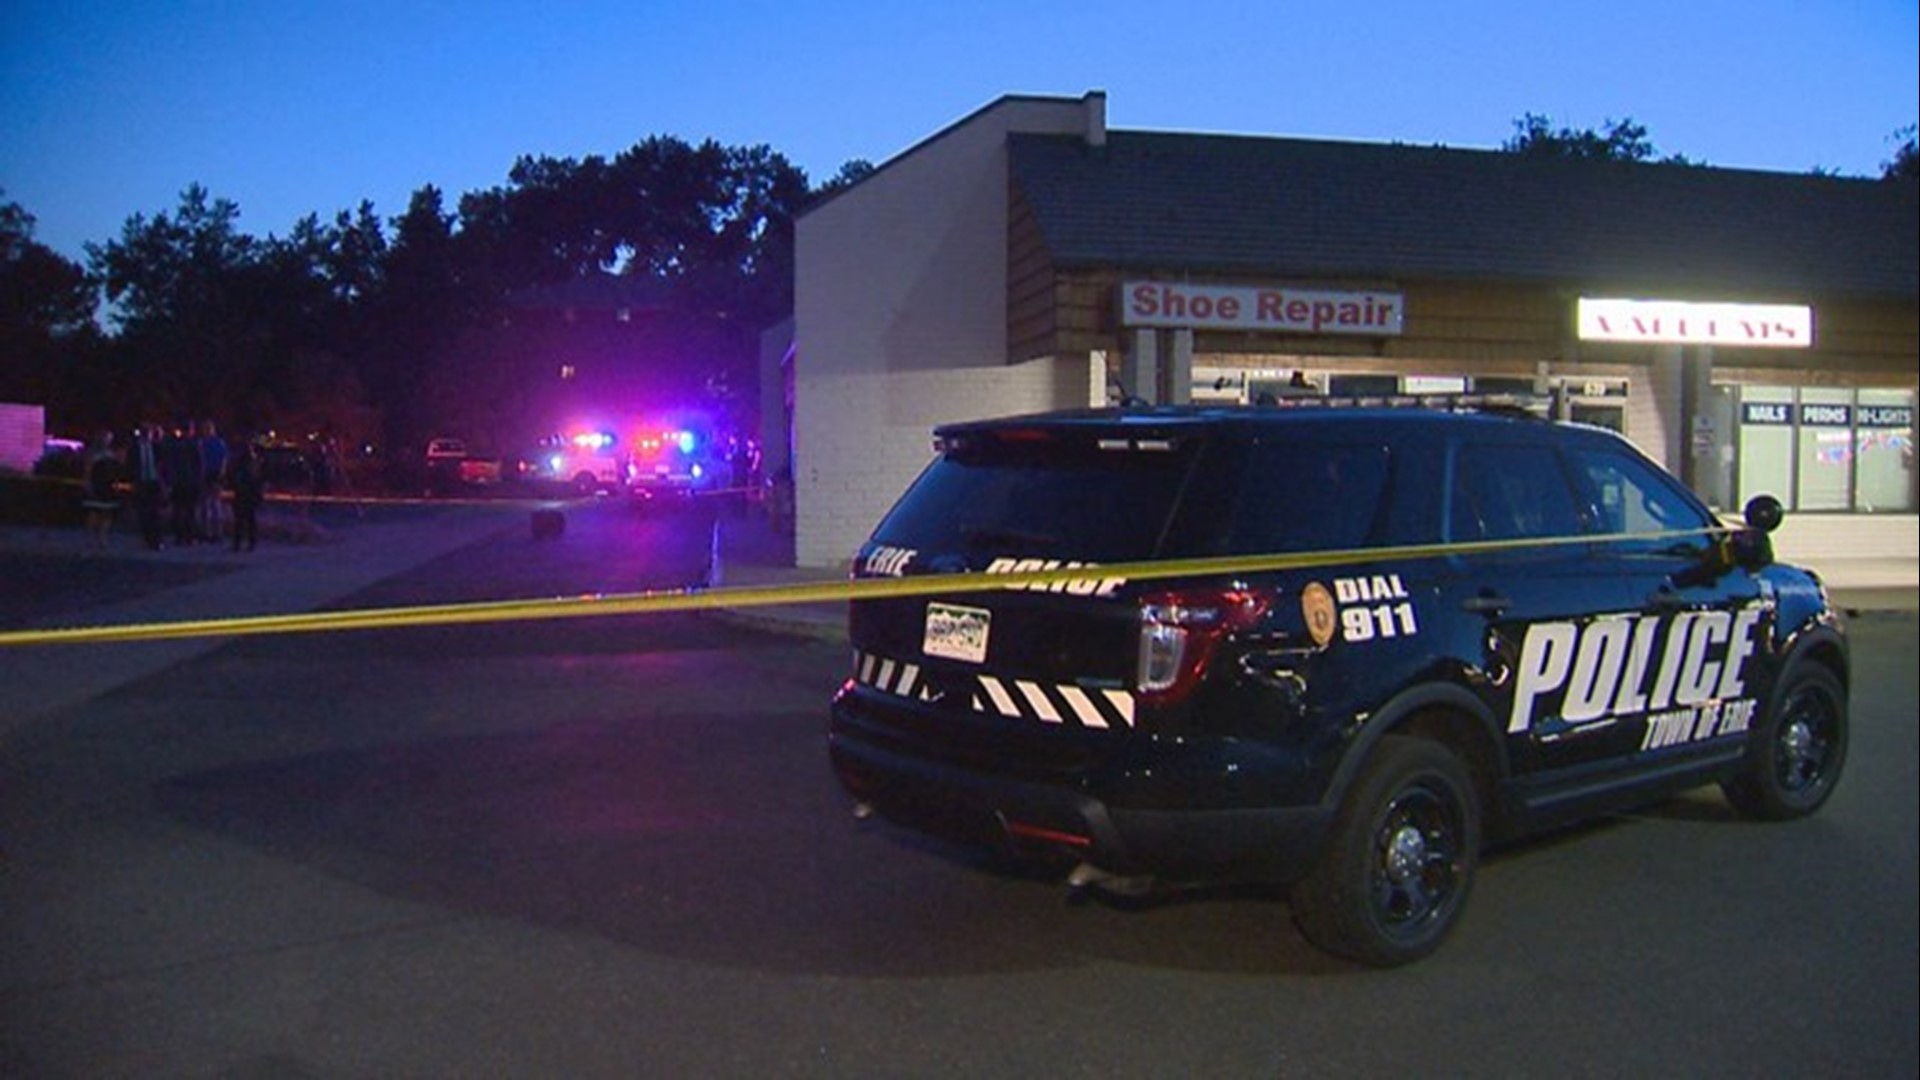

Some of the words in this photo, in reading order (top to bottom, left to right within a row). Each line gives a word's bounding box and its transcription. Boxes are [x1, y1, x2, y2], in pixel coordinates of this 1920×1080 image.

[1132, 284, 1241, 320] Shoe
[1256, 290, 1393, 331] Repair
[1749, 406, 1786, 422] NAILS
[1803, 407, 1847, 424] PERMS
[865, 546, 918, 576] ERIE
[1334, 574, 1409, 603] DIAL
[1341, 602, 1417, 642] 911
[1507, 610, 1760, 733] POLICE
[1641, 708, 1697, 751] TOWN
[1717, 699, 1757, 735] ERIE
